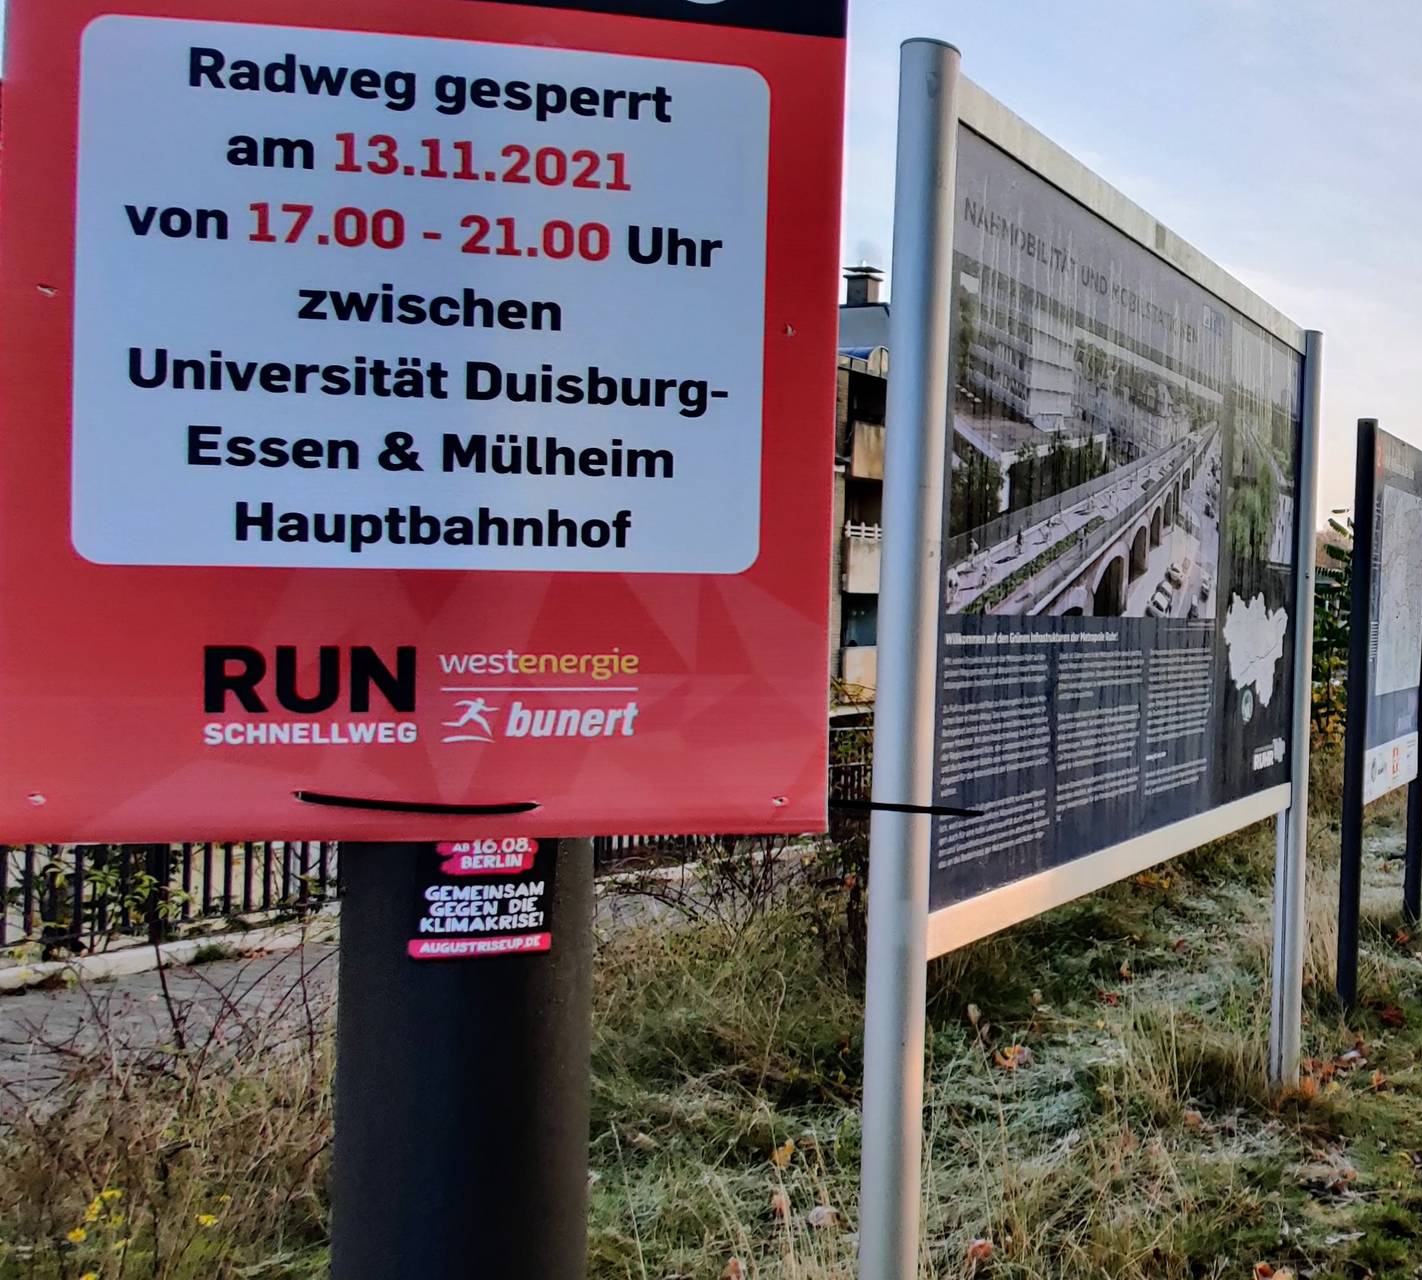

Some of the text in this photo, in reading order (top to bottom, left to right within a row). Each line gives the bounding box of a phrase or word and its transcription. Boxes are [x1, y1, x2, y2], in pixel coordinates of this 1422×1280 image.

[189, 47, 672, 123] Radweg gesperrt
[227, 133, 631, 191] am 13.11.2021
[124, 203, 722, 267] von 17.00 - 21.00 Uhr
[1081, 265, 1108, 295] UND
[298, 283, 561, 331] zwischen
[129, 348, 728, 417] Universität Duisburg-
[188, 425, 673, 478] Essen & Mülheim
[236, 502, 631, 552] Hauptbahnhof
[204, 646, 416, 714] RUN
[440, 648, 638, 680] westenergie
[204, 723, 416, 744] SCHNELLWEG
[506, 702, 638, 737] bunert
[452, 837, 533, 854] AB 16.08.
[460, 854, 523, 870] BERLIN
[425, 881, 545, 902] GEMEINSAM
[429, 897, 537, 917] GEGEN DIE
[419, 911, 545, 933] KLIMAKRISE!
[419, 936, 542, 954] AUGUSTRISEUP.DE
